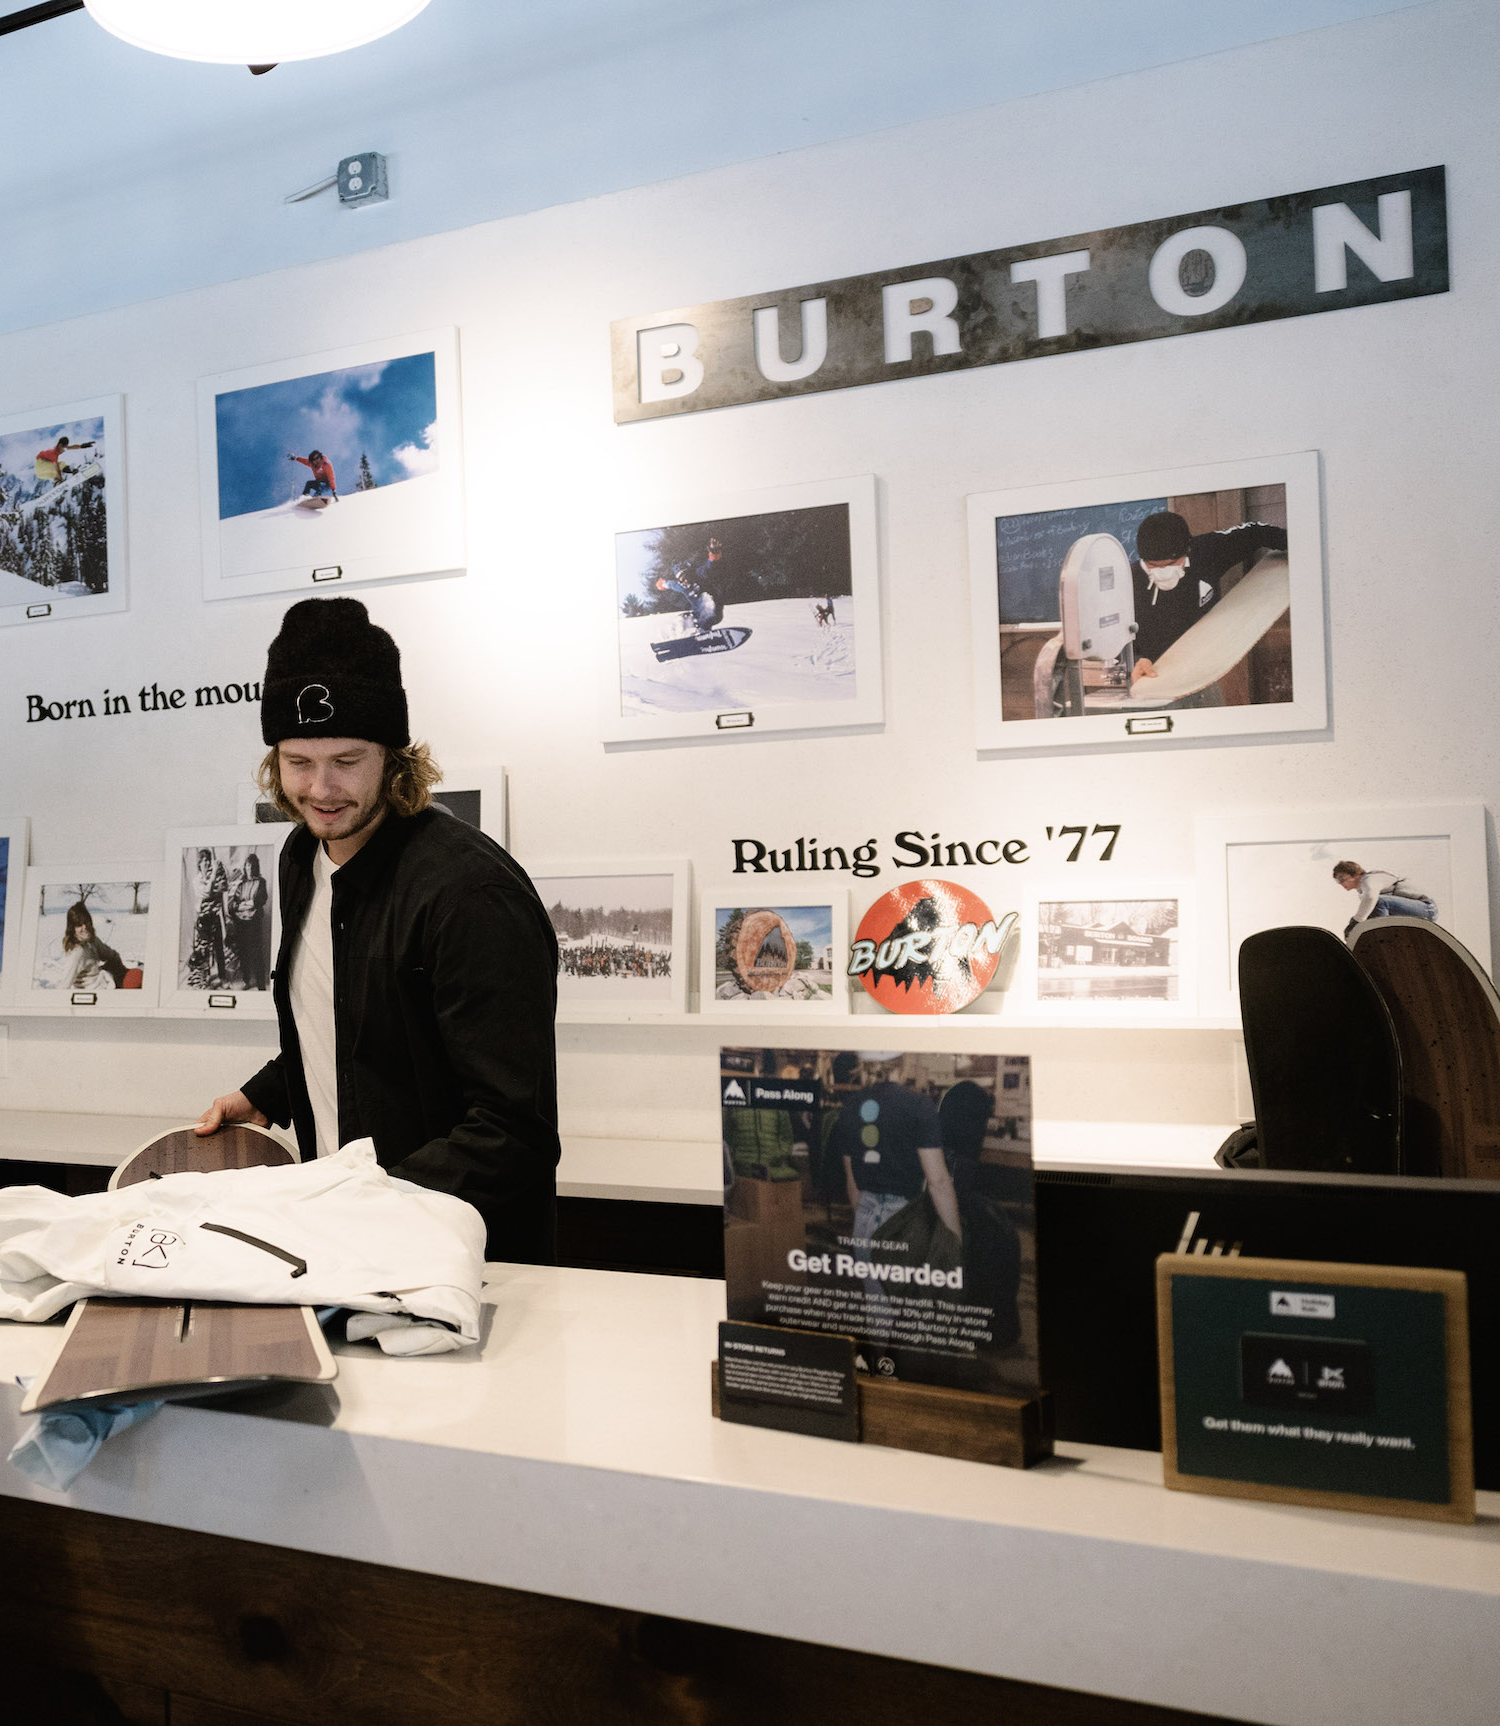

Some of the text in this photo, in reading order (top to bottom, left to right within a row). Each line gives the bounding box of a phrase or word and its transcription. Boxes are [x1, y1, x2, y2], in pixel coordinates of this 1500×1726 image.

[637, 190, 1414, 404] BURTON
[26, 682, 262, 722] Born in the mou
[732, 824, 1121, 878] Ruling Since '77
[847, 911, 1019, 976] BURTON
[756, 1087, 814, 1104] Pass Along
[117, 1223, 144, 1264] BURTON
[838, 1236, 909, 1252] TRADE IN GEAR
[787, 1249, 963, 1289] Get Rewarded
[762, 1280, 783, 1291] Keep
[784, 1284, 801, 1293] your
[804, 1286, 822, 1295] gear
[836, 1289, 849, 1298] the
[866, 1293, 879, 1301] not
[880, 1294, 889, 1302] in
[890, 1296, 904, 1305] the
[937, 1300, 955, 1311] This
[788, 1295, 811, 1305] credit
[813, 1298, 832, 1307] AND
[833, 1300, 847, 1310] get
[848, 1302, 859, 1310] an
[860, 1304, 901, 1316] additional
[903, 1308, 921, 1317] 10%
[922, 1311, 935, 1320] off
[936, 1314, 952, 1324] any
[953, 1315, 988, 1328] in-store
[765, 1303, 802, 1314] purchase
[803, 1308, 825, 1317] when
[826, 1311, 842, 1320] you
[843, 1312, 865, 1323] trade
[875, 1317, 894, 1327] your
[896, 1320, 916, 1330] used
[918, 1321, 948, 1333] Burton
[961, 1327, 992, 1342] Analog
[780, 1318, 820, 1327] outerwear
[822, 1322, 837, 1330] and
[839, 1324, 890, 1338] snowboards
[891, 1330, 925, 1343] through
[926, 1334, 947, 1345] Pass
[755, 1346, 786, 1356] RETURNS
[1203, 1416, 1415, 1450] Get them what they really want.
